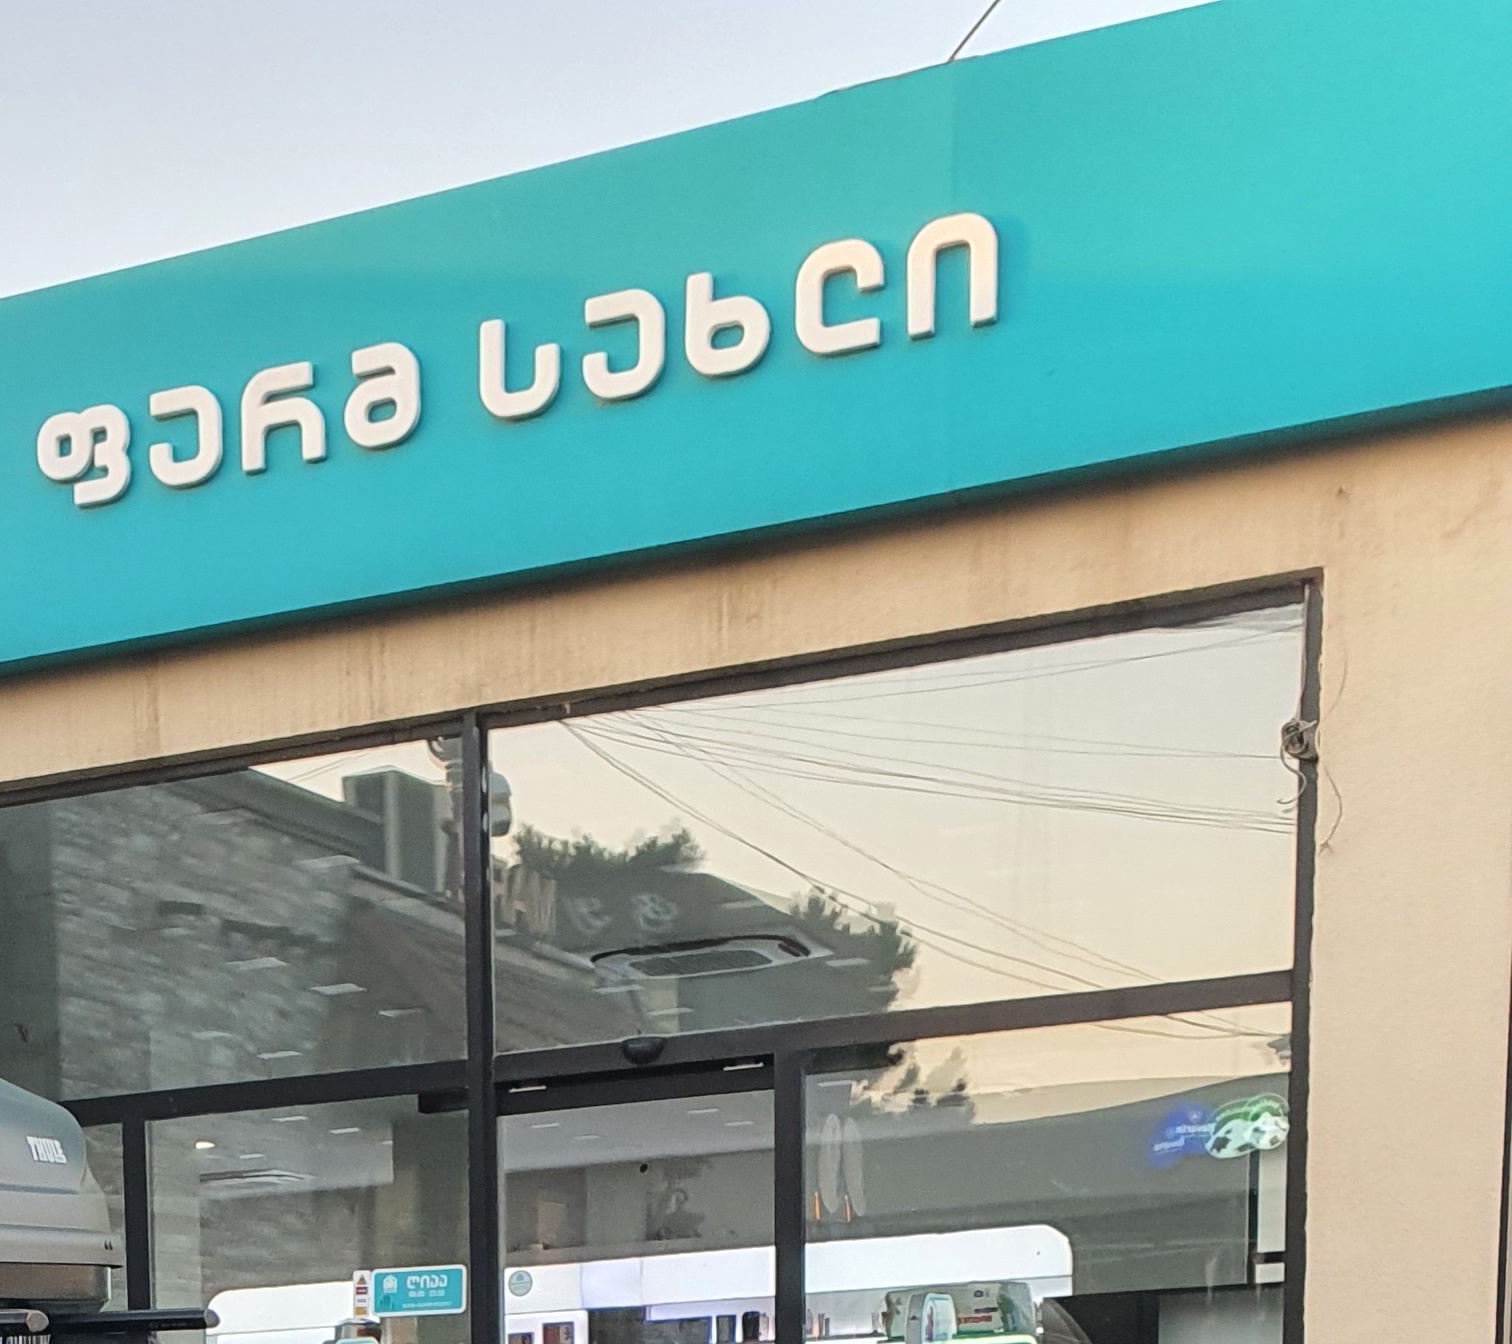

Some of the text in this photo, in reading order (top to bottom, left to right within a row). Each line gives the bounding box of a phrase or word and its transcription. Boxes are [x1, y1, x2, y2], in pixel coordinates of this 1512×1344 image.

[36, 211, 999, 509] ფარმ სახლი
[26, 1136, 67, 1164] THULE
